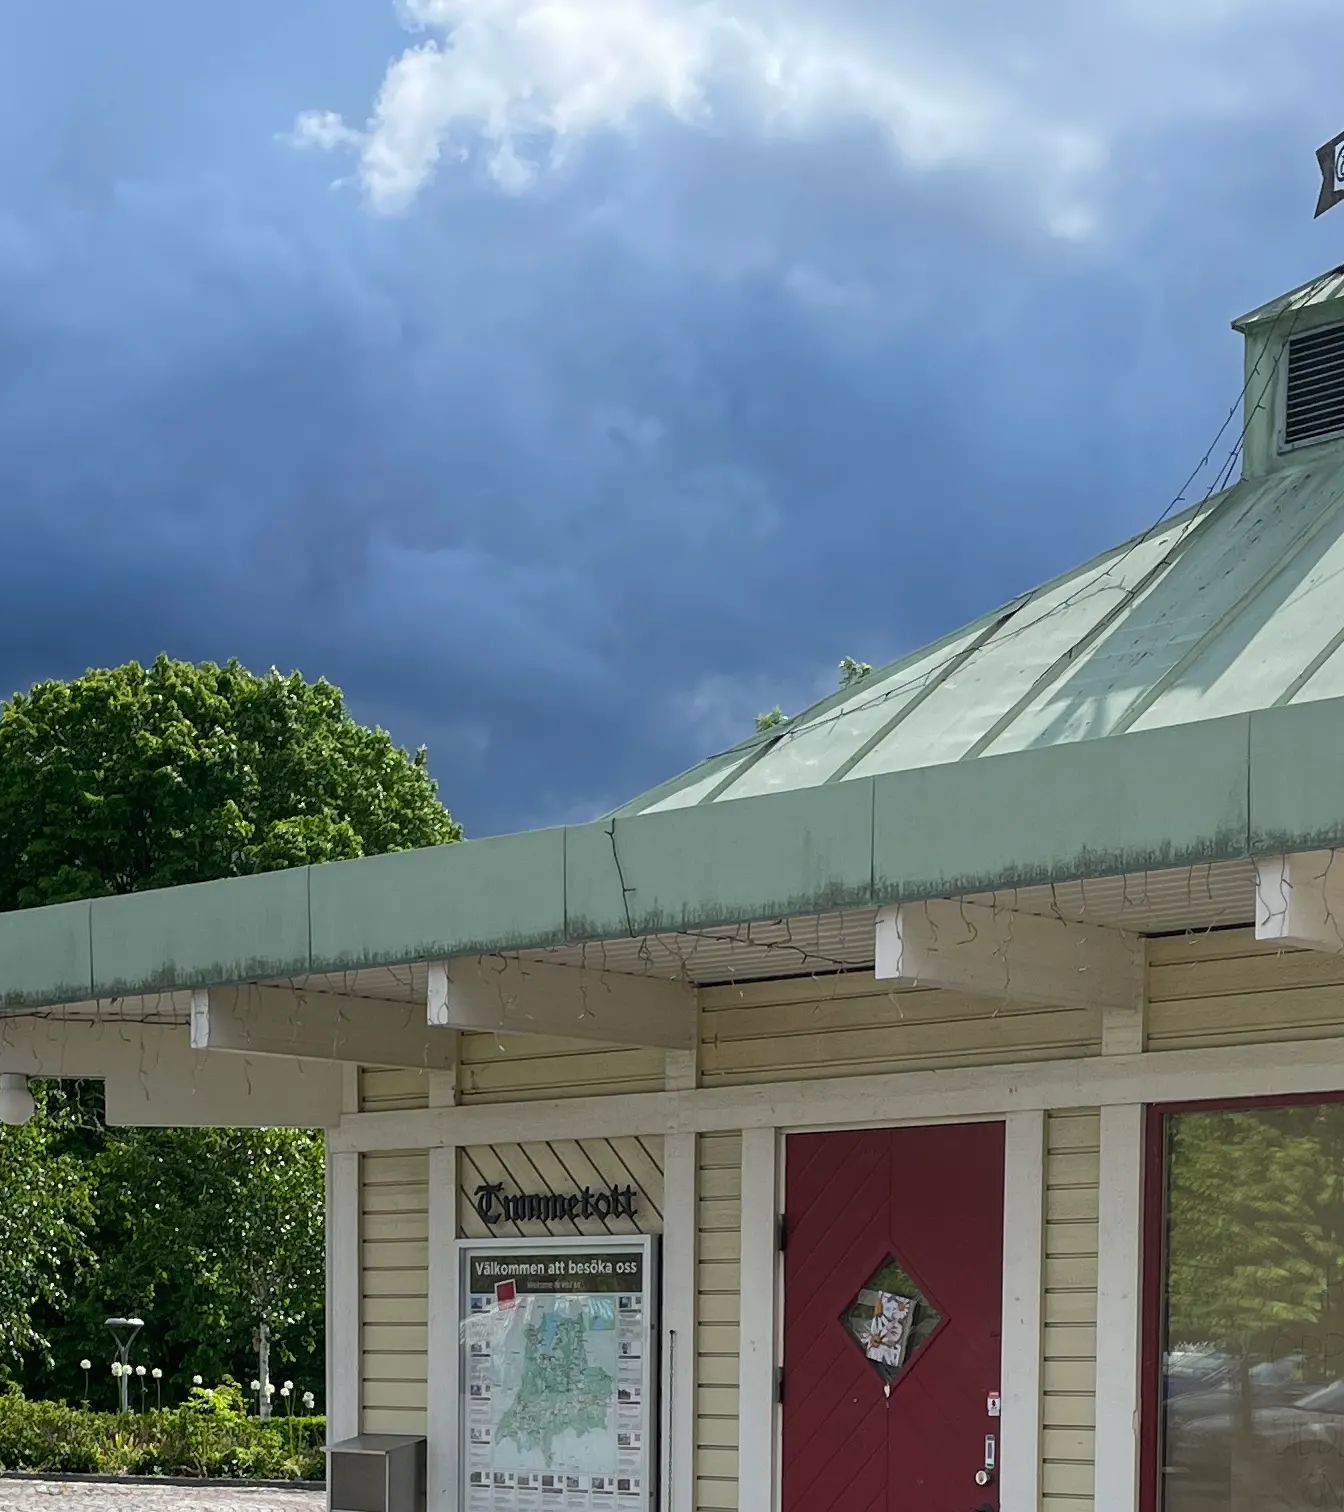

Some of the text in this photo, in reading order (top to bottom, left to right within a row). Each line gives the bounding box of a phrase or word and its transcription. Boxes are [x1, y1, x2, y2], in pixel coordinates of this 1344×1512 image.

[474, 1181, 638, 1224] Tummetott
[475, 1259, 637, 1276] Välkommen att besöka oss
